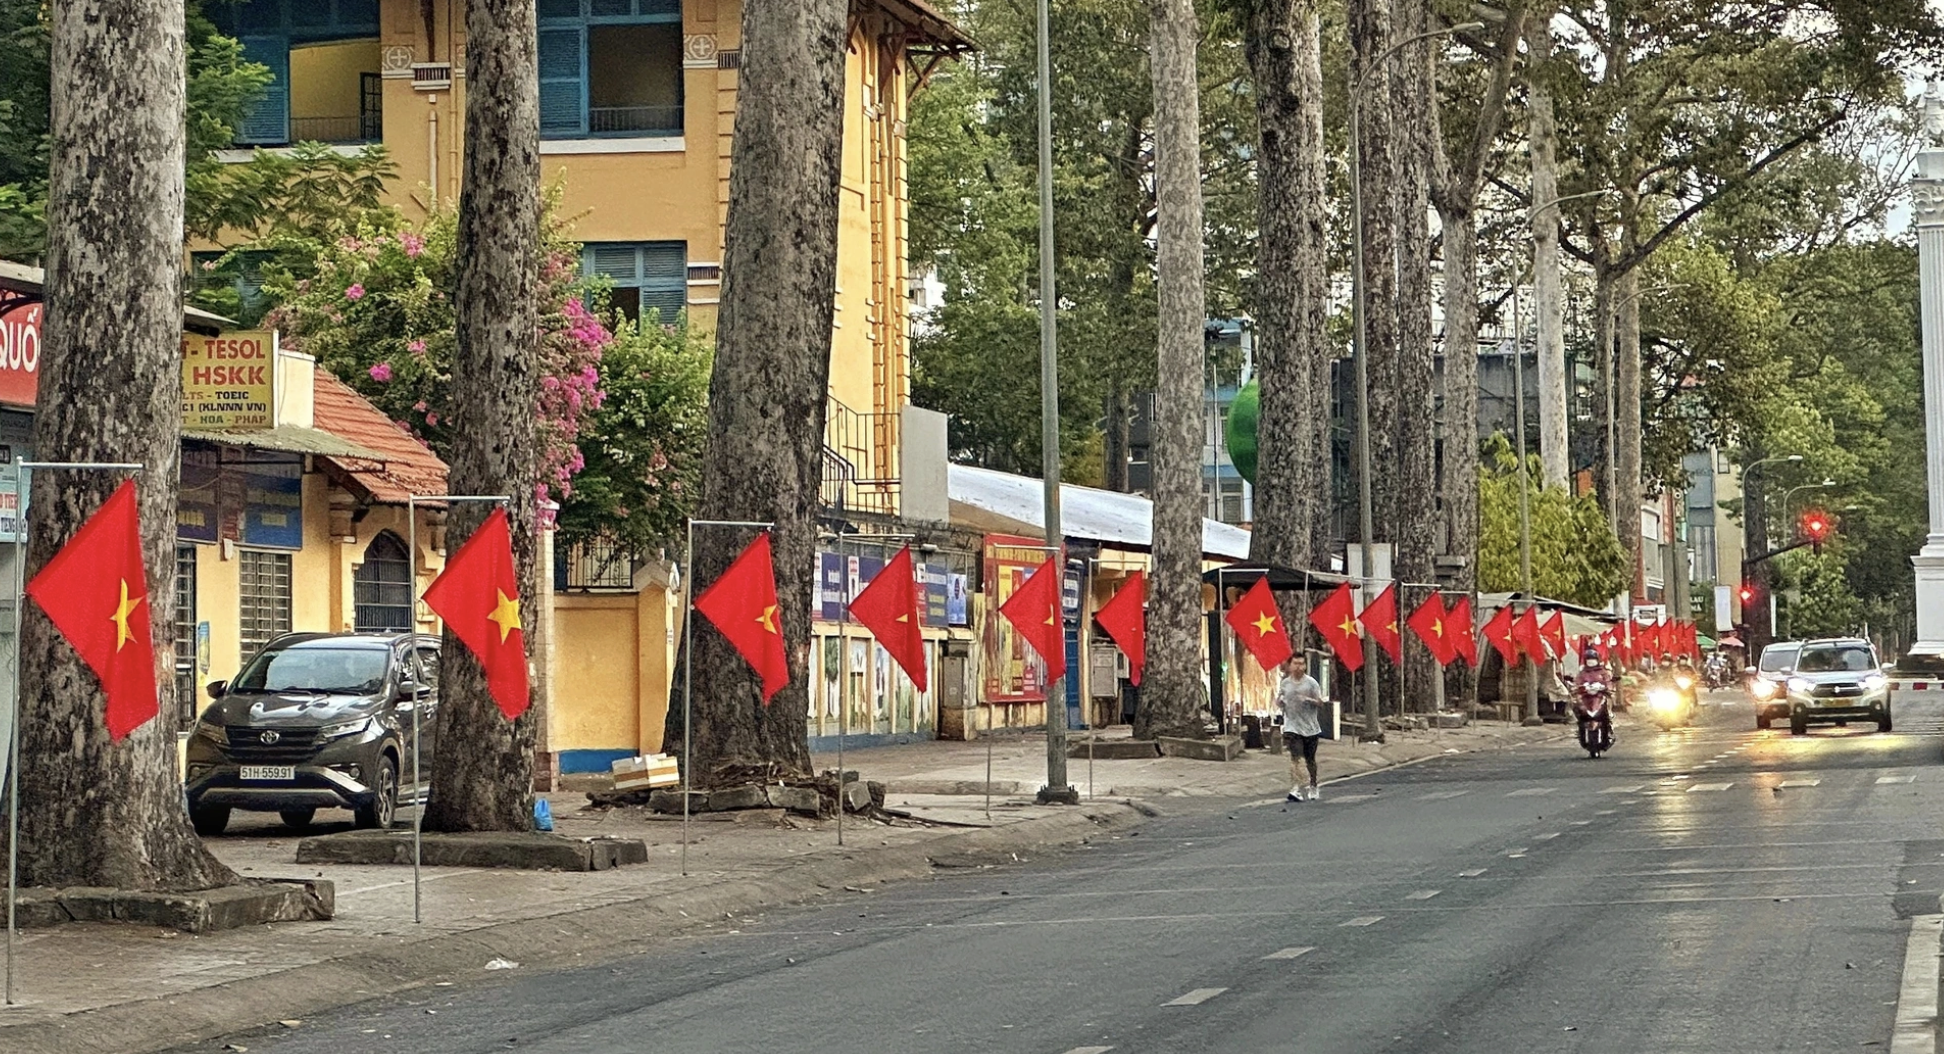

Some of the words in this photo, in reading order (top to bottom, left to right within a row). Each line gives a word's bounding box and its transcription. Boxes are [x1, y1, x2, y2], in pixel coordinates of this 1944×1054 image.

[204, 339, 266, 359] TESOL
[192, 365, 266, 385] HSKK
[215, 391, 249, 400] TOEIC
[246, 402, 266, 412] VN)
[200, 415, 224, 425] HOA
